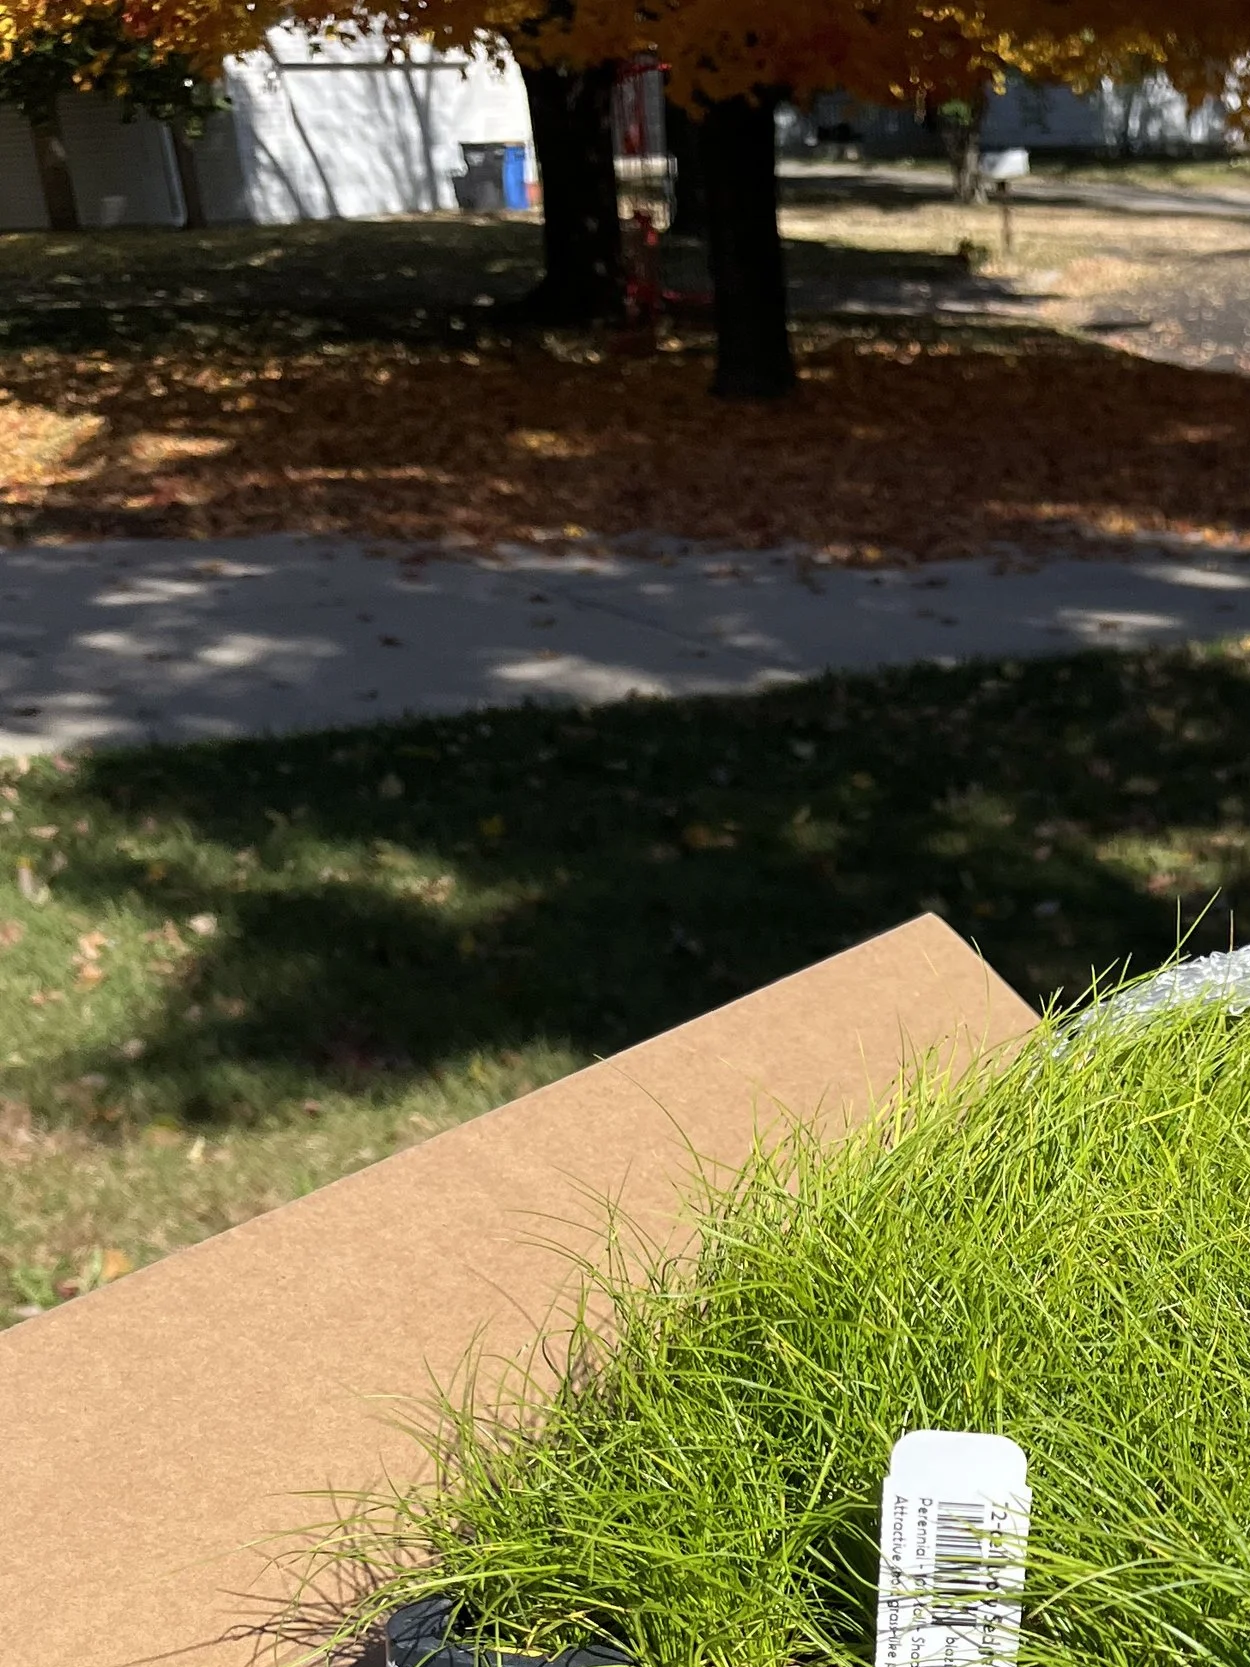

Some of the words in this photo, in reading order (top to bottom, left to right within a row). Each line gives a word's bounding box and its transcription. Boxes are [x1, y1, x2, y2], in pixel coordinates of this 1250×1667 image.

[892, 1495, 909, 1561] Attractive
[916, 1497, 933, 1559] Perennial
[980, 1564, 1006, 1607] Ivoy
